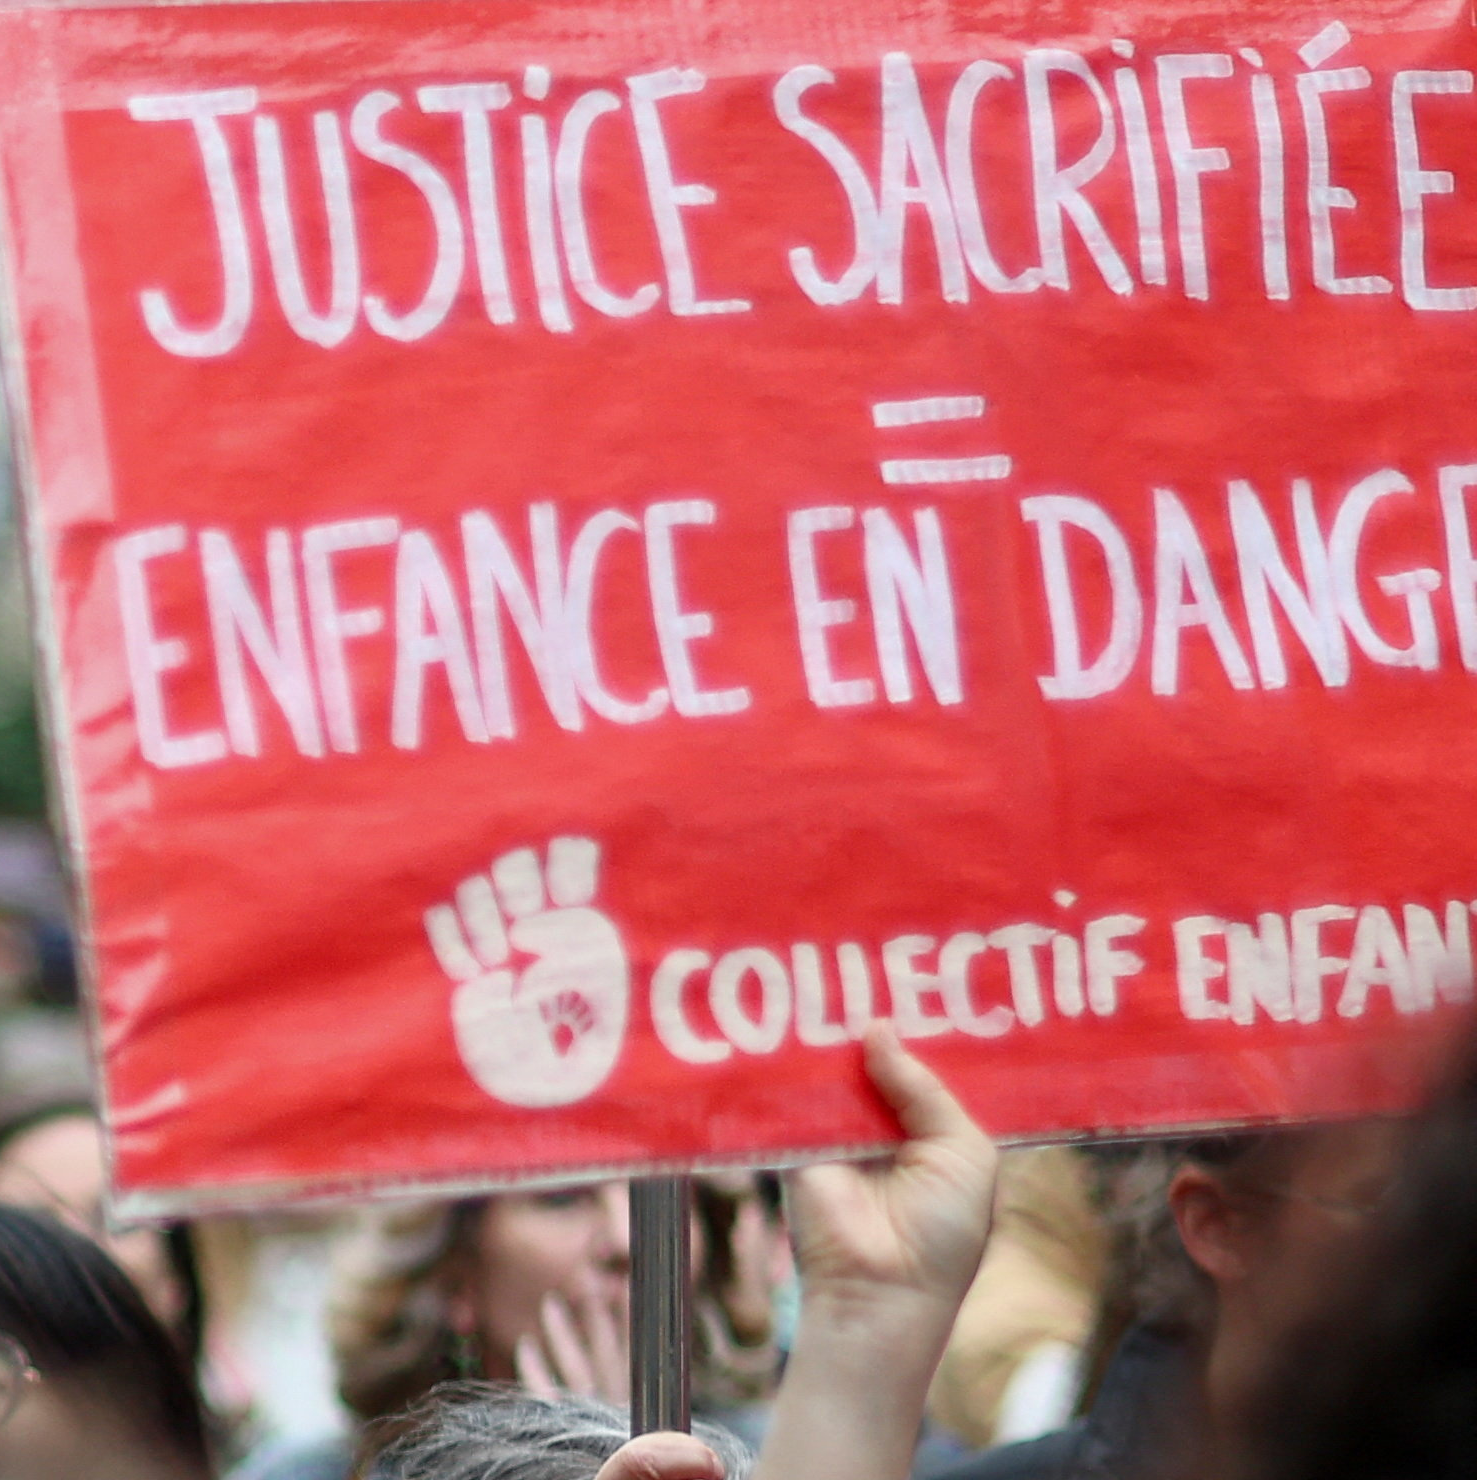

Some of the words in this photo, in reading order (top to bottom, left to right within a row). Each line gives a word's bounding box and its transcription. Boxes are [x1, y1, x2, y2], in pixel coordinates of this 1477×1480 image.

[115, 498, 750, 769] ENFANCE
[789, 506, 962, 707] EN
[1172, 899, 1477, 1025] ENFAN
